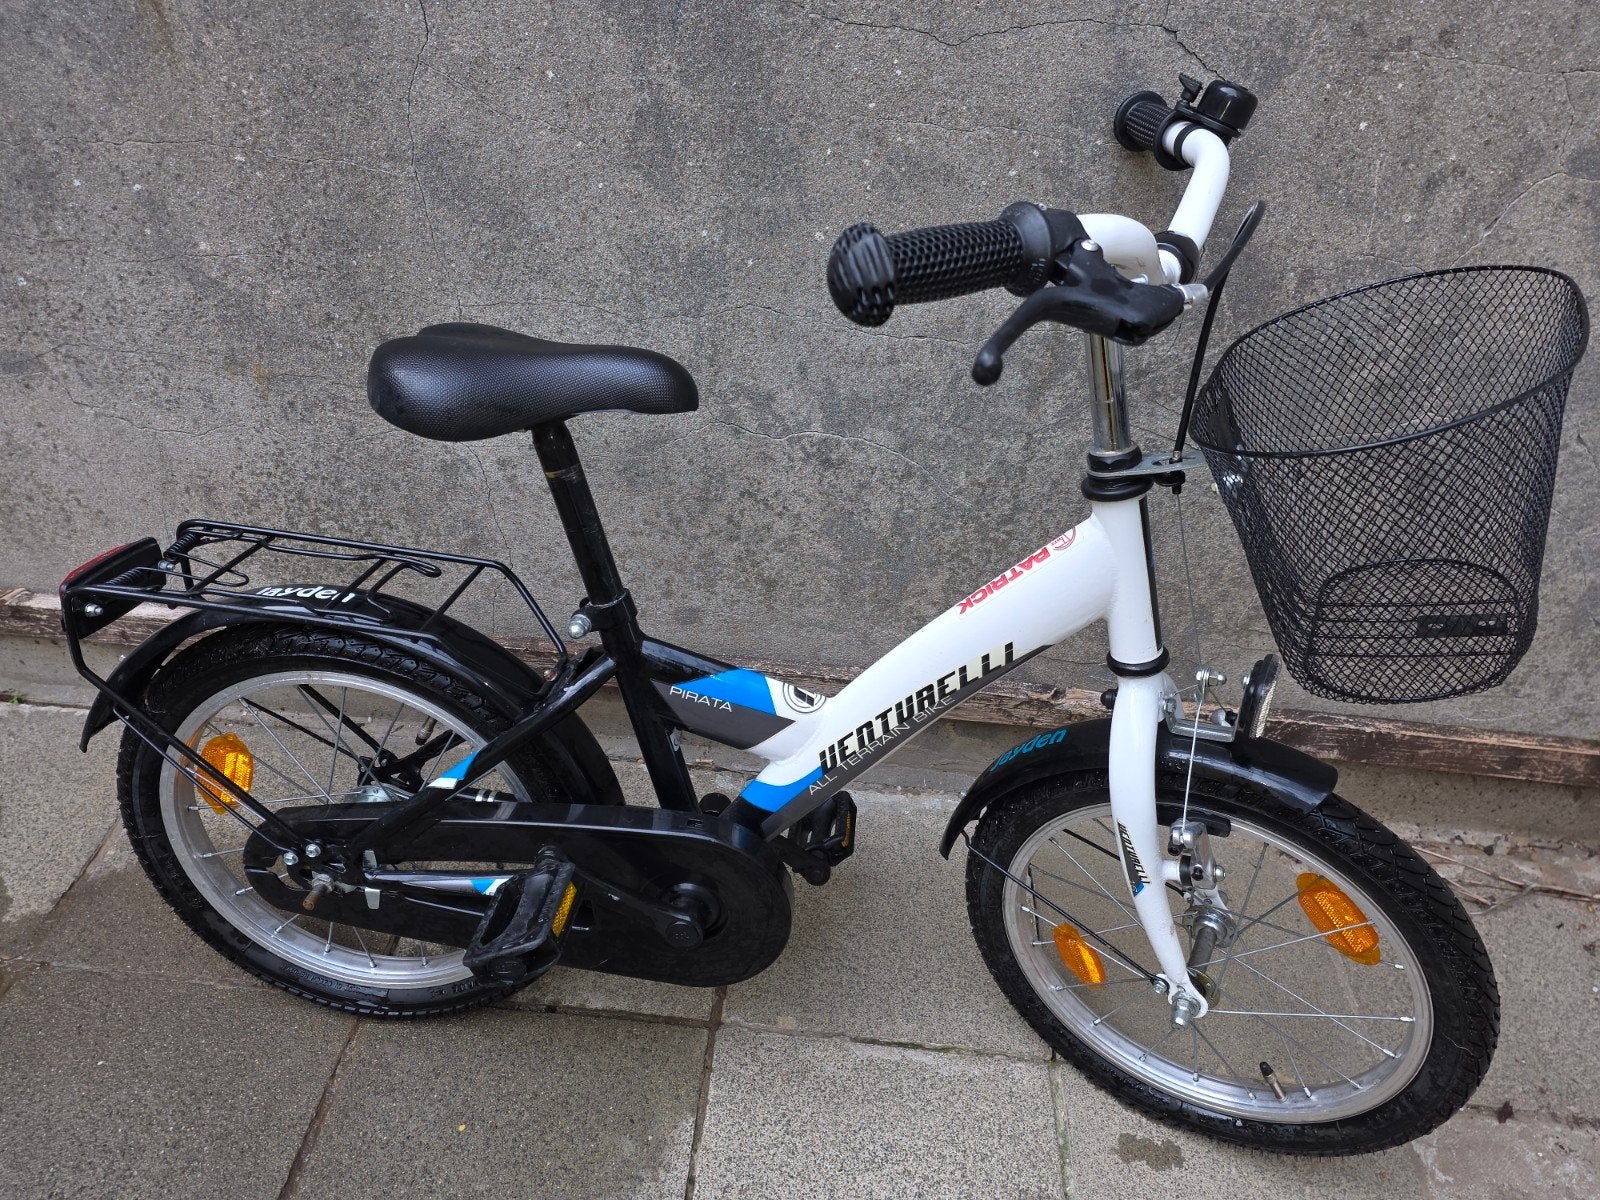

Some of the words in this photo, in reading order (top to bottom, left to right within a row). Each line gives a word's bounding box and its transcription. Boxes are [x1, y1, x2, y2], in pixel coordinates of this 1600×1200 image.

[669, 685, 733, 713] PIRATA
[808, 774, 838, 796] ALL
[838, 721, 911, 771] TERRAIN
[912, 696, 956, 723] BIKE
[819, 641, 1014, 773] VENTURELLI
